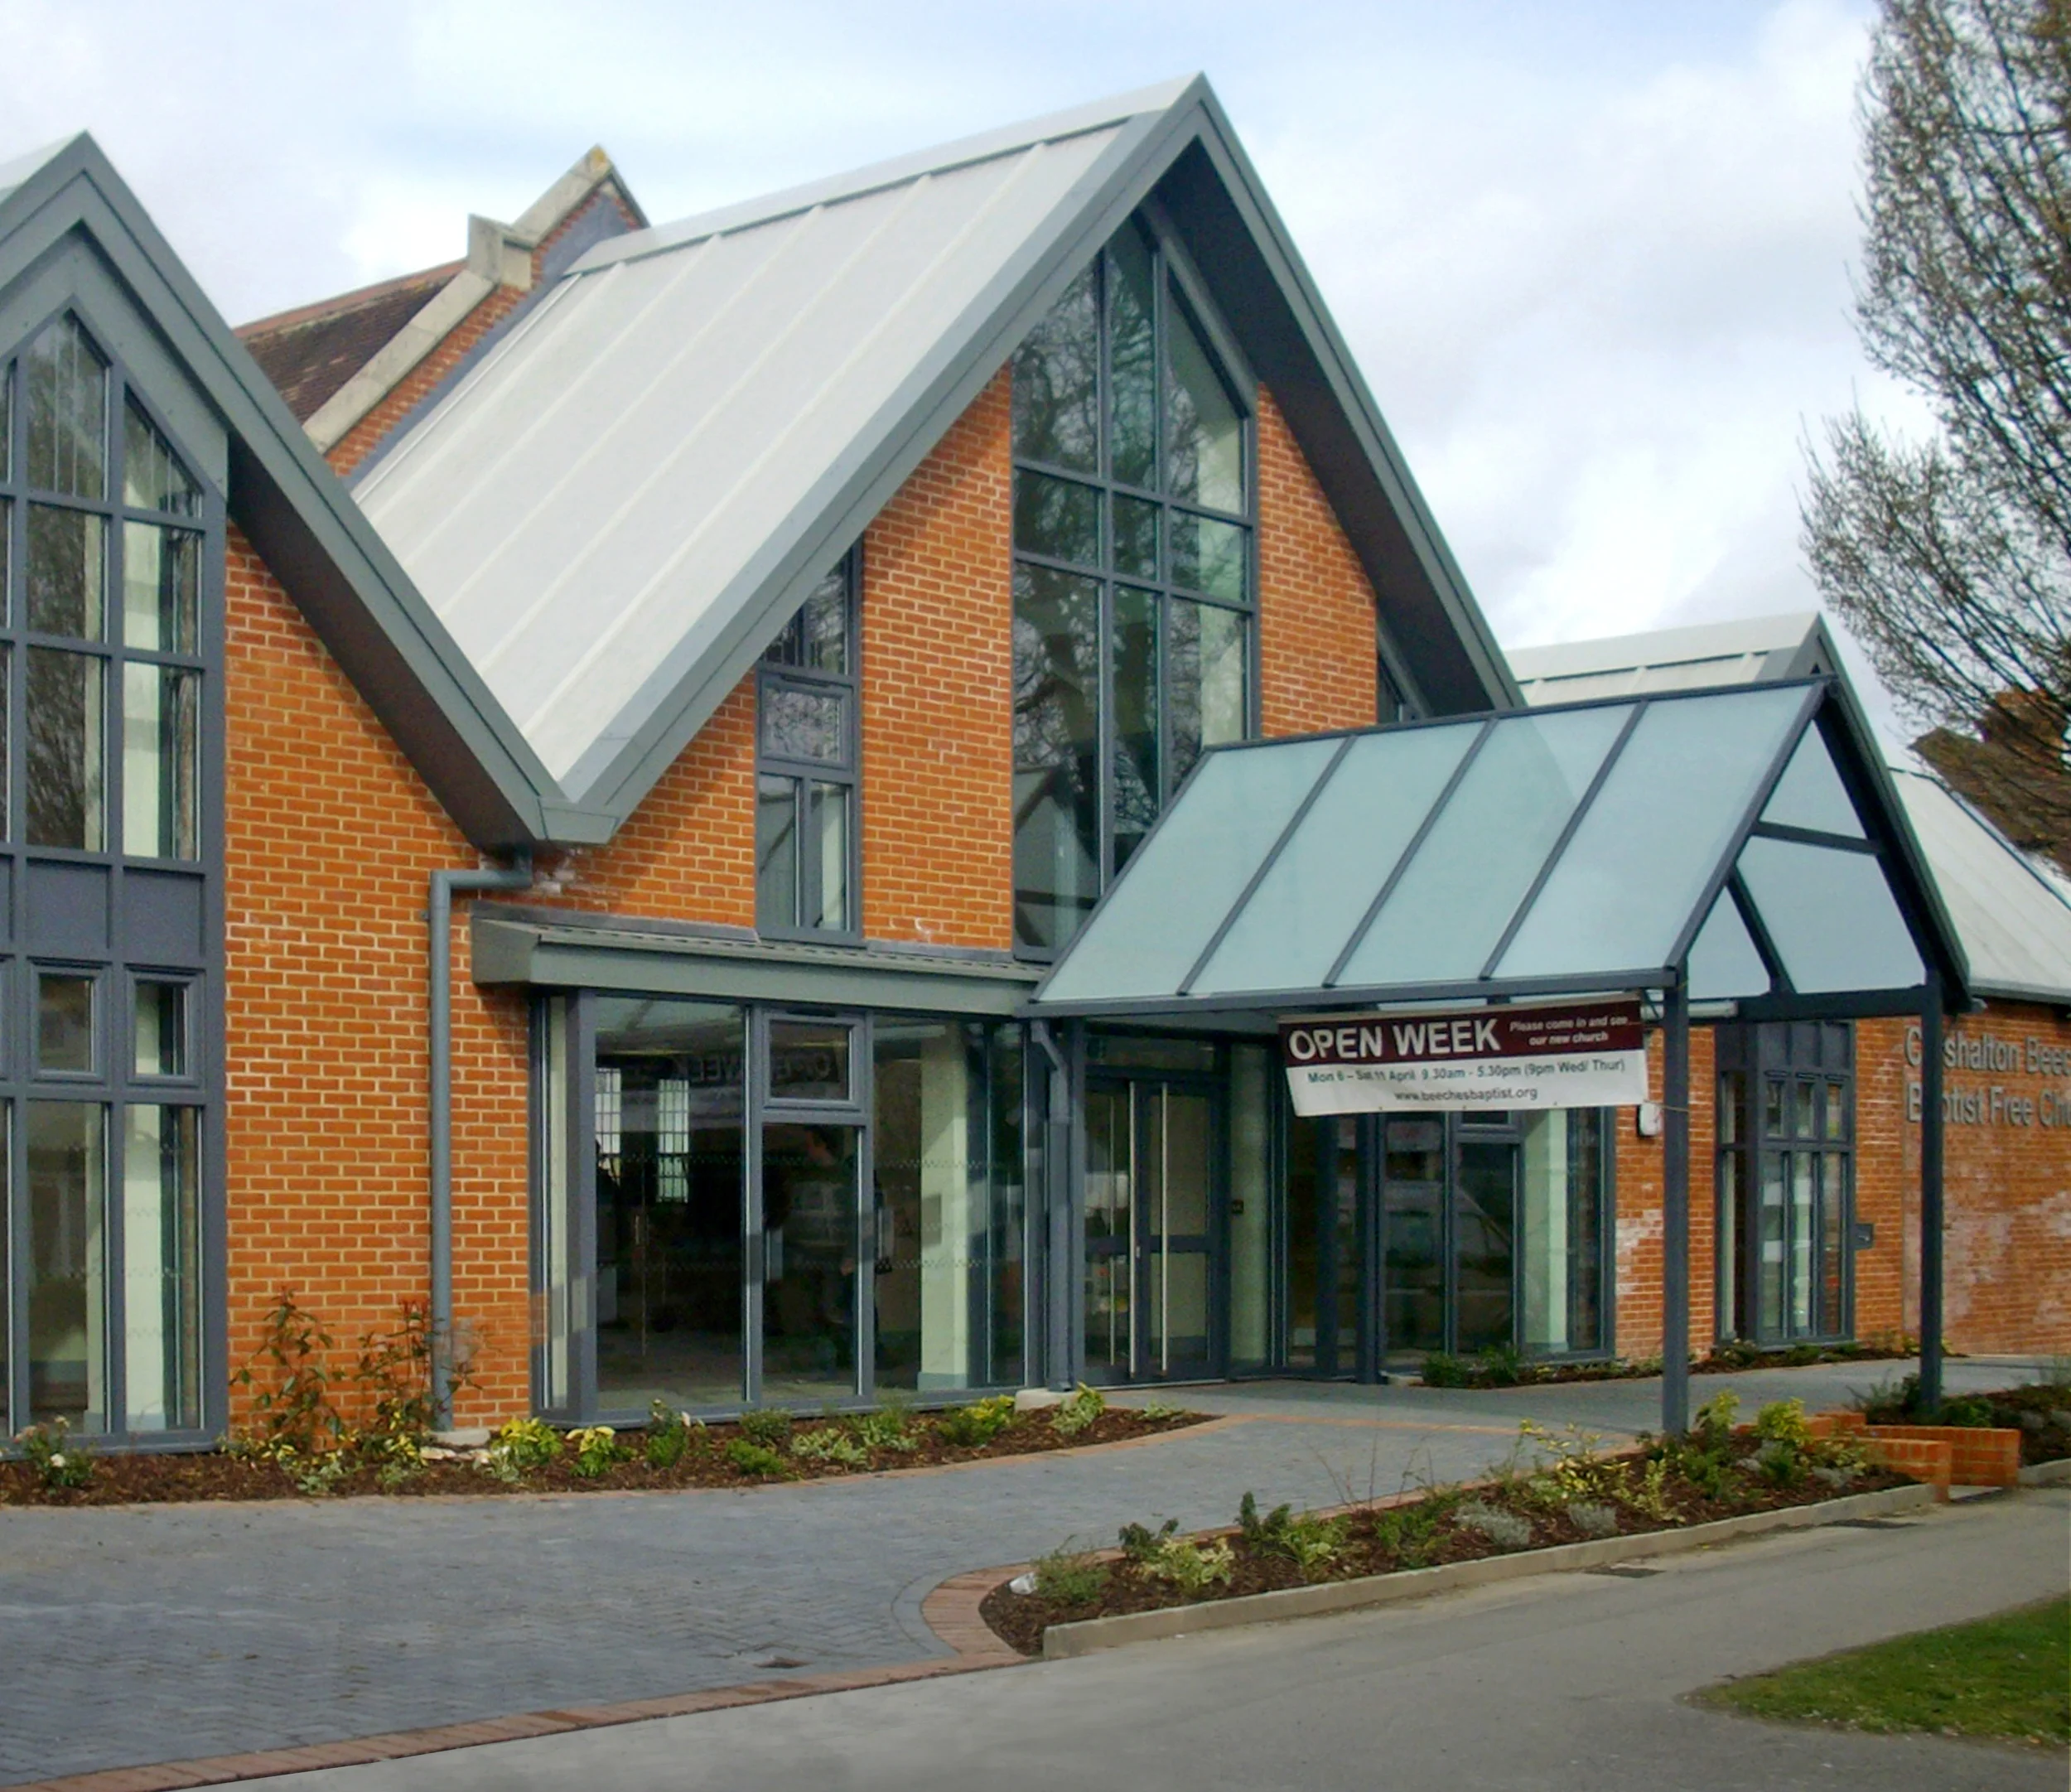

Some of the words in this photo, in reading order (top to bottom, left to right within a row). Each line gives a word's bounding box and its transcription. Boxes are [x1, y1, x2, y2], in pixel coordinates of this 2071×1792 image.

[1509, 1021, 1543, 1031] Please
[1546, 1020, 1574, 1030] come
[1576, 1017, 1587, 1028] in
[1588, 1016, 1608, 1027] and
[1289, 1026, 1383, 1060] OPEN
[1393, 1018, 1501, 1056] WEEK
[1528, 1035, 1547, 1046] our
[1548, 1035, 1571, 1046] new
[1572, 1031, 1610, 1044] church
[1904, 1026, 2019, 1071] Cshalton
[1307, 1072, 1334, 1083] Mon
[1389, 1068, 1416, 1082] April
[1524, 1063, 1555, 1077] (9pm
[1592, 1058, 1625, 1073] Thur)
[1393, 1087, 1538, 1102] www.beechesbaptist.org
[1990, 1085, 2033, 1127] Free
